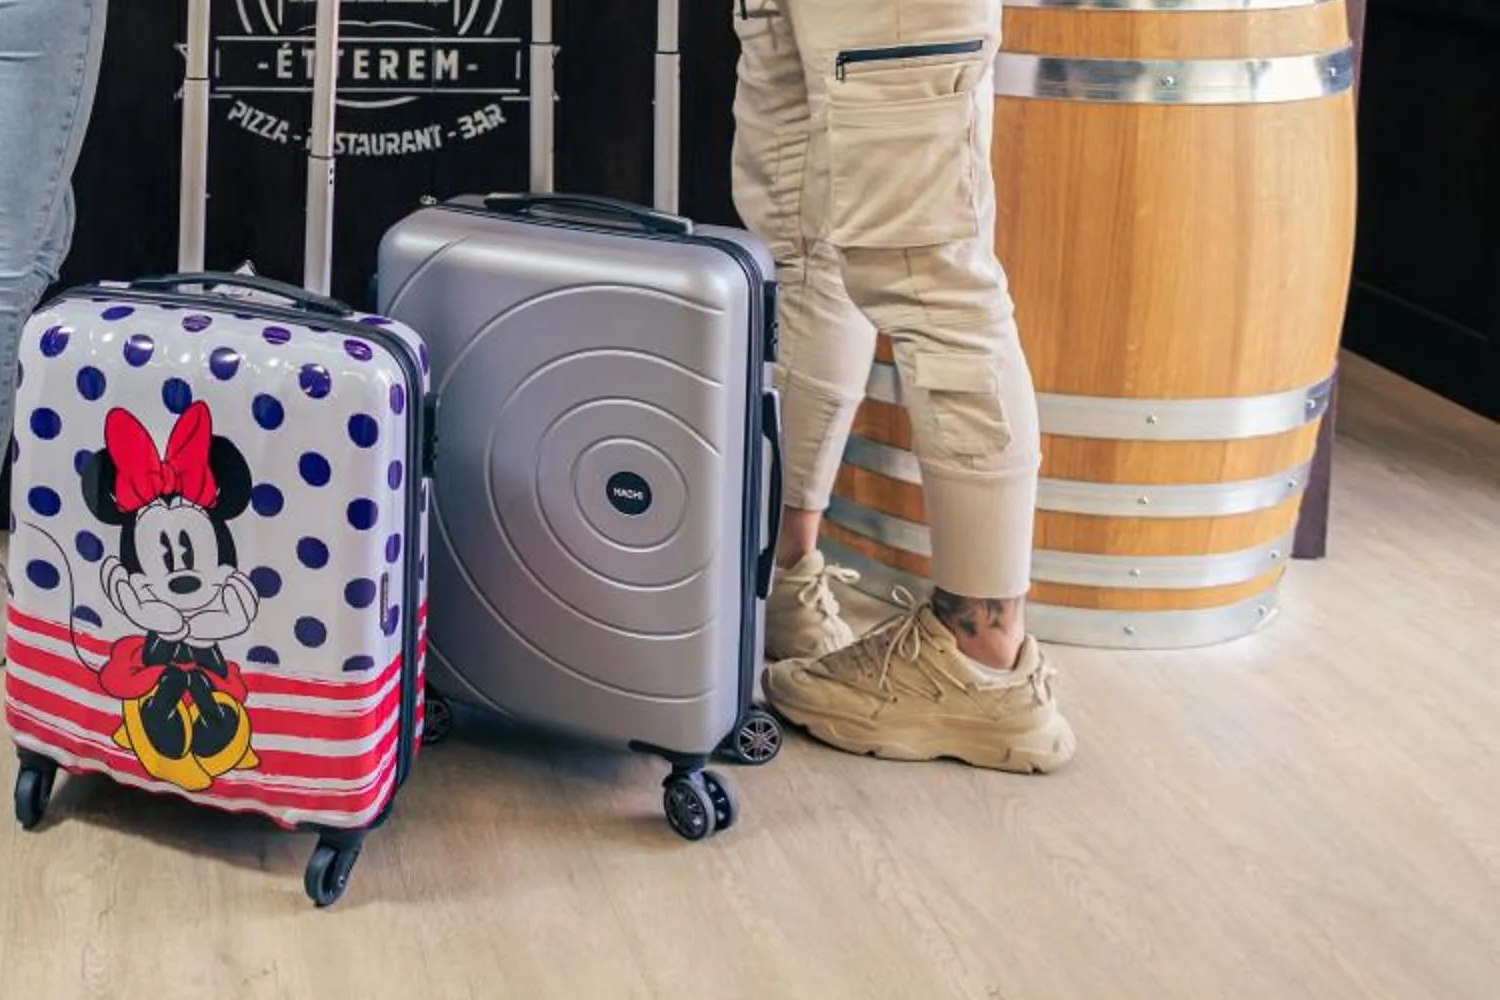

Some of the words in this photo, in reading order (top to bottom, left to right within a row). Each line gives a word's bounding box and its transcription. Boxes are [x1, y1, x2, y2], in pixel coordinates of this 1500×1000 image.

[228, 100, 290, 144] PIZZA
[306, 124, 442, 156] STAURANT
[457, 103, 507, 140] BAR
